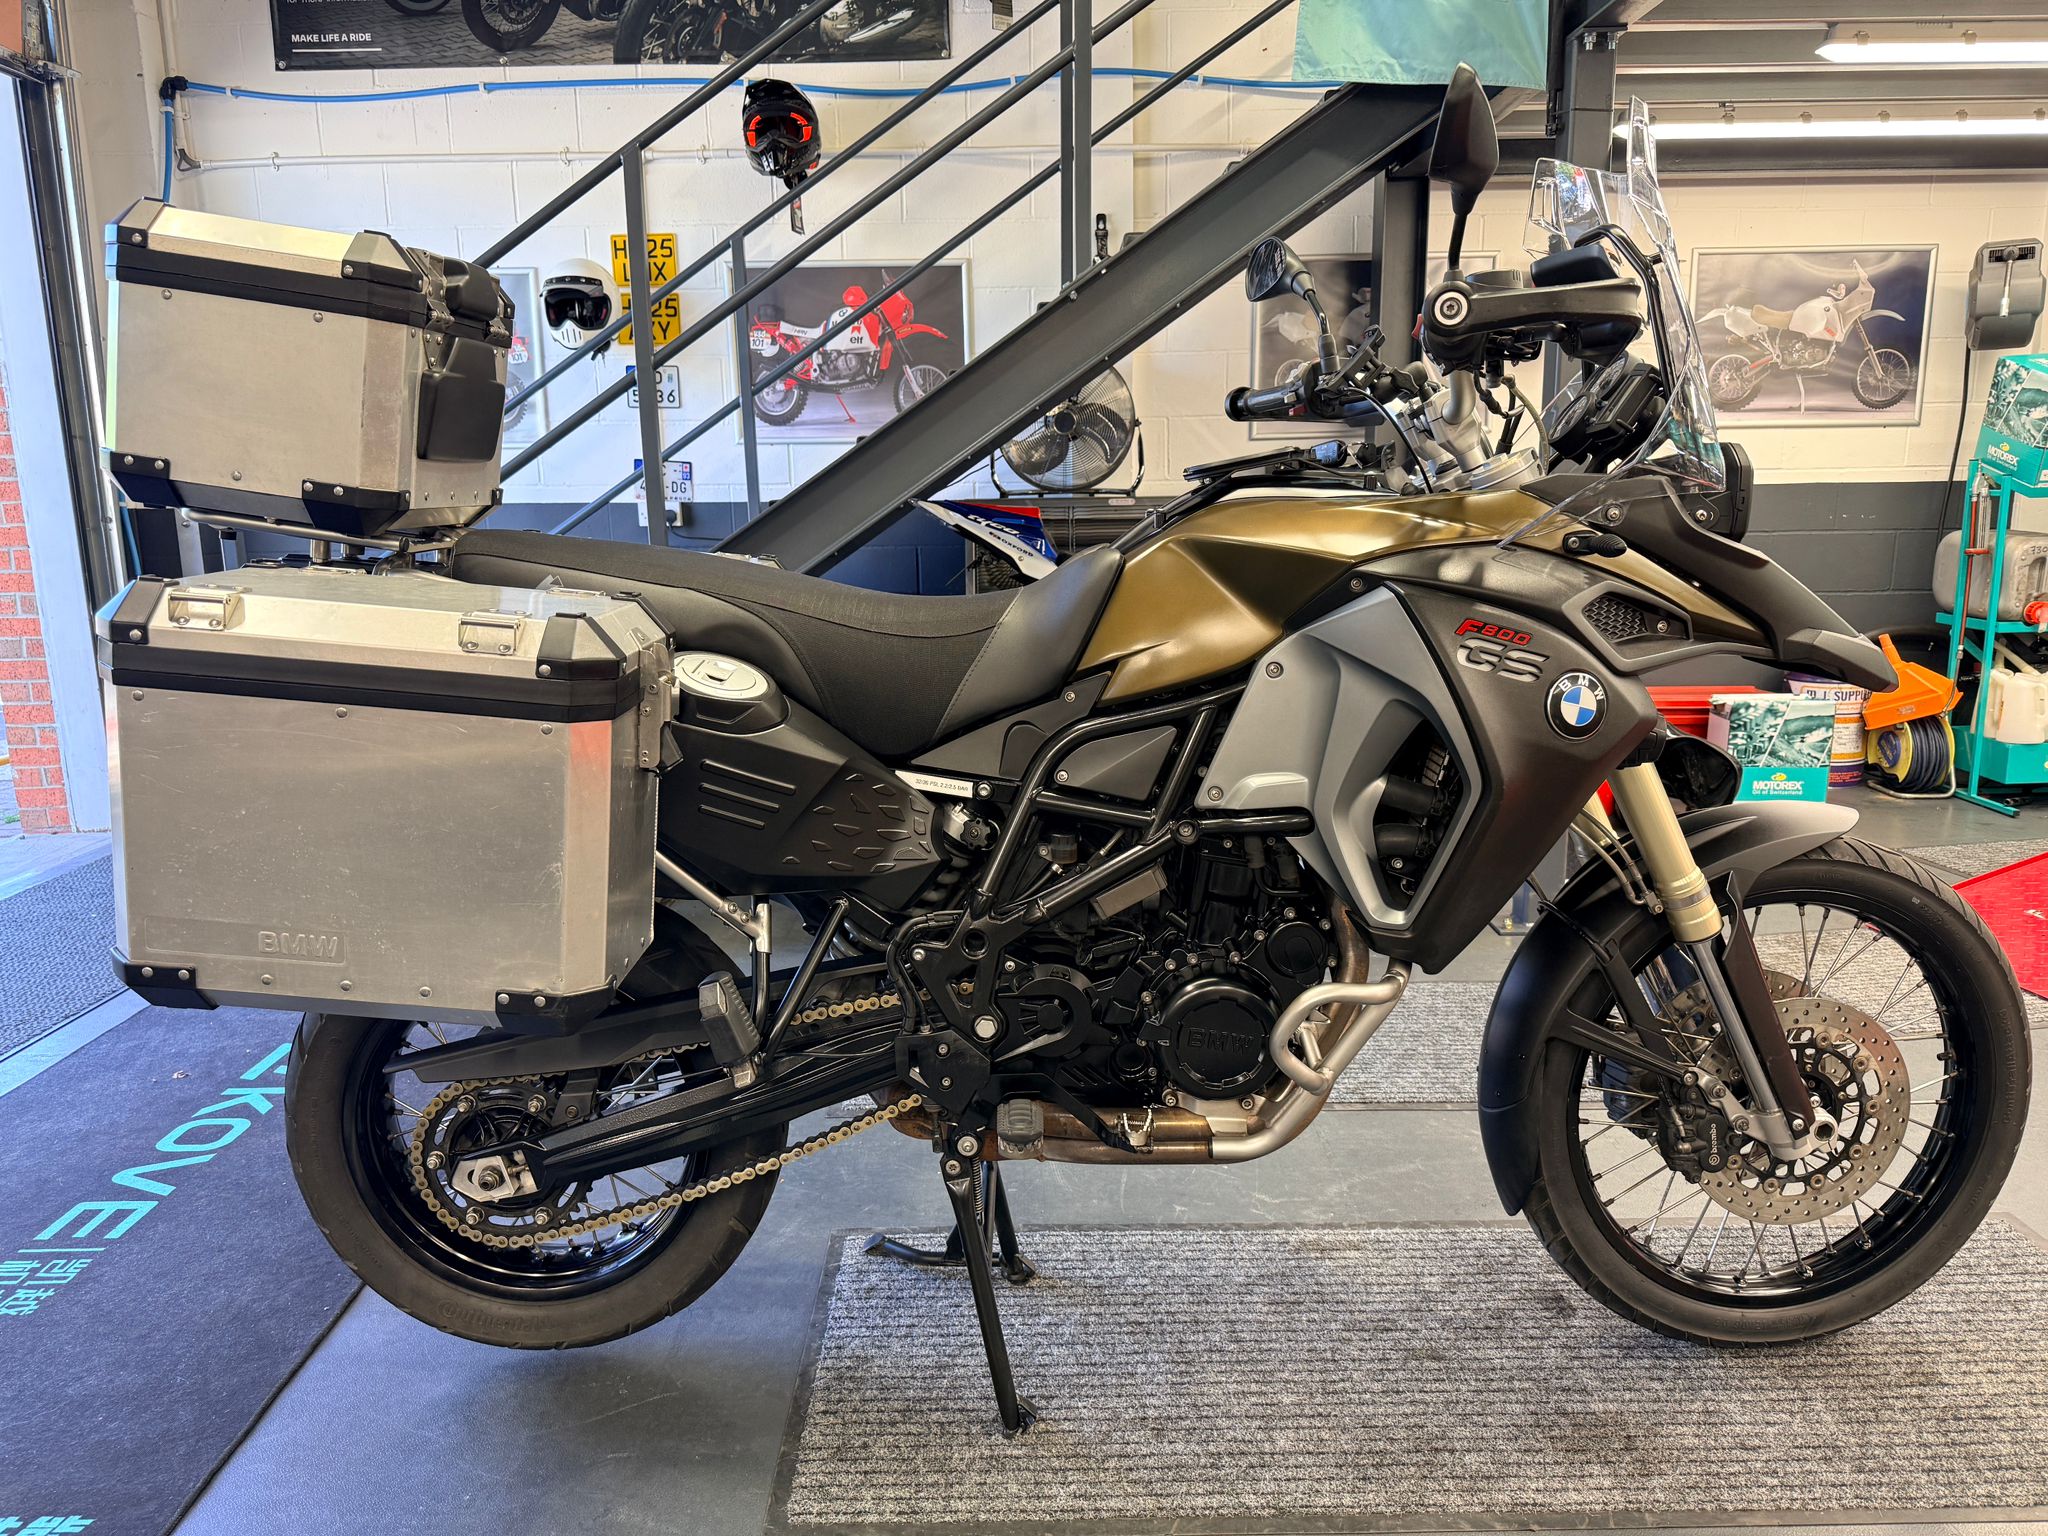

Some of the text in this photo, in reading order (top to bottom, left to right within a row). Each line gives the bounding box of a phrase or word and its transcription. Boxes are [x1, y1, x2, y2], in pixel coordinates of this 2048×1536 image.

[291, 33, 372, 42] MAKE LIFE A RIDE
[614, 238, 673, 259] H25
[751, 338, 764, 347] 101
[849, 335, 863, 344] elf
[1455, 618, 1532, 646] F800
[1456, 637, 1550, 683] GS
[1558, 674, 1605, 701] BMW
[1752, 780, 1804, 790] MOTOREX
[258, 930, 338, 958] BMW
[1187, 1026, 1254, 1056] BMW
[1709, 1122, 1719, 1154] brembo
[33, 1086, 287, 1241] KOVE
